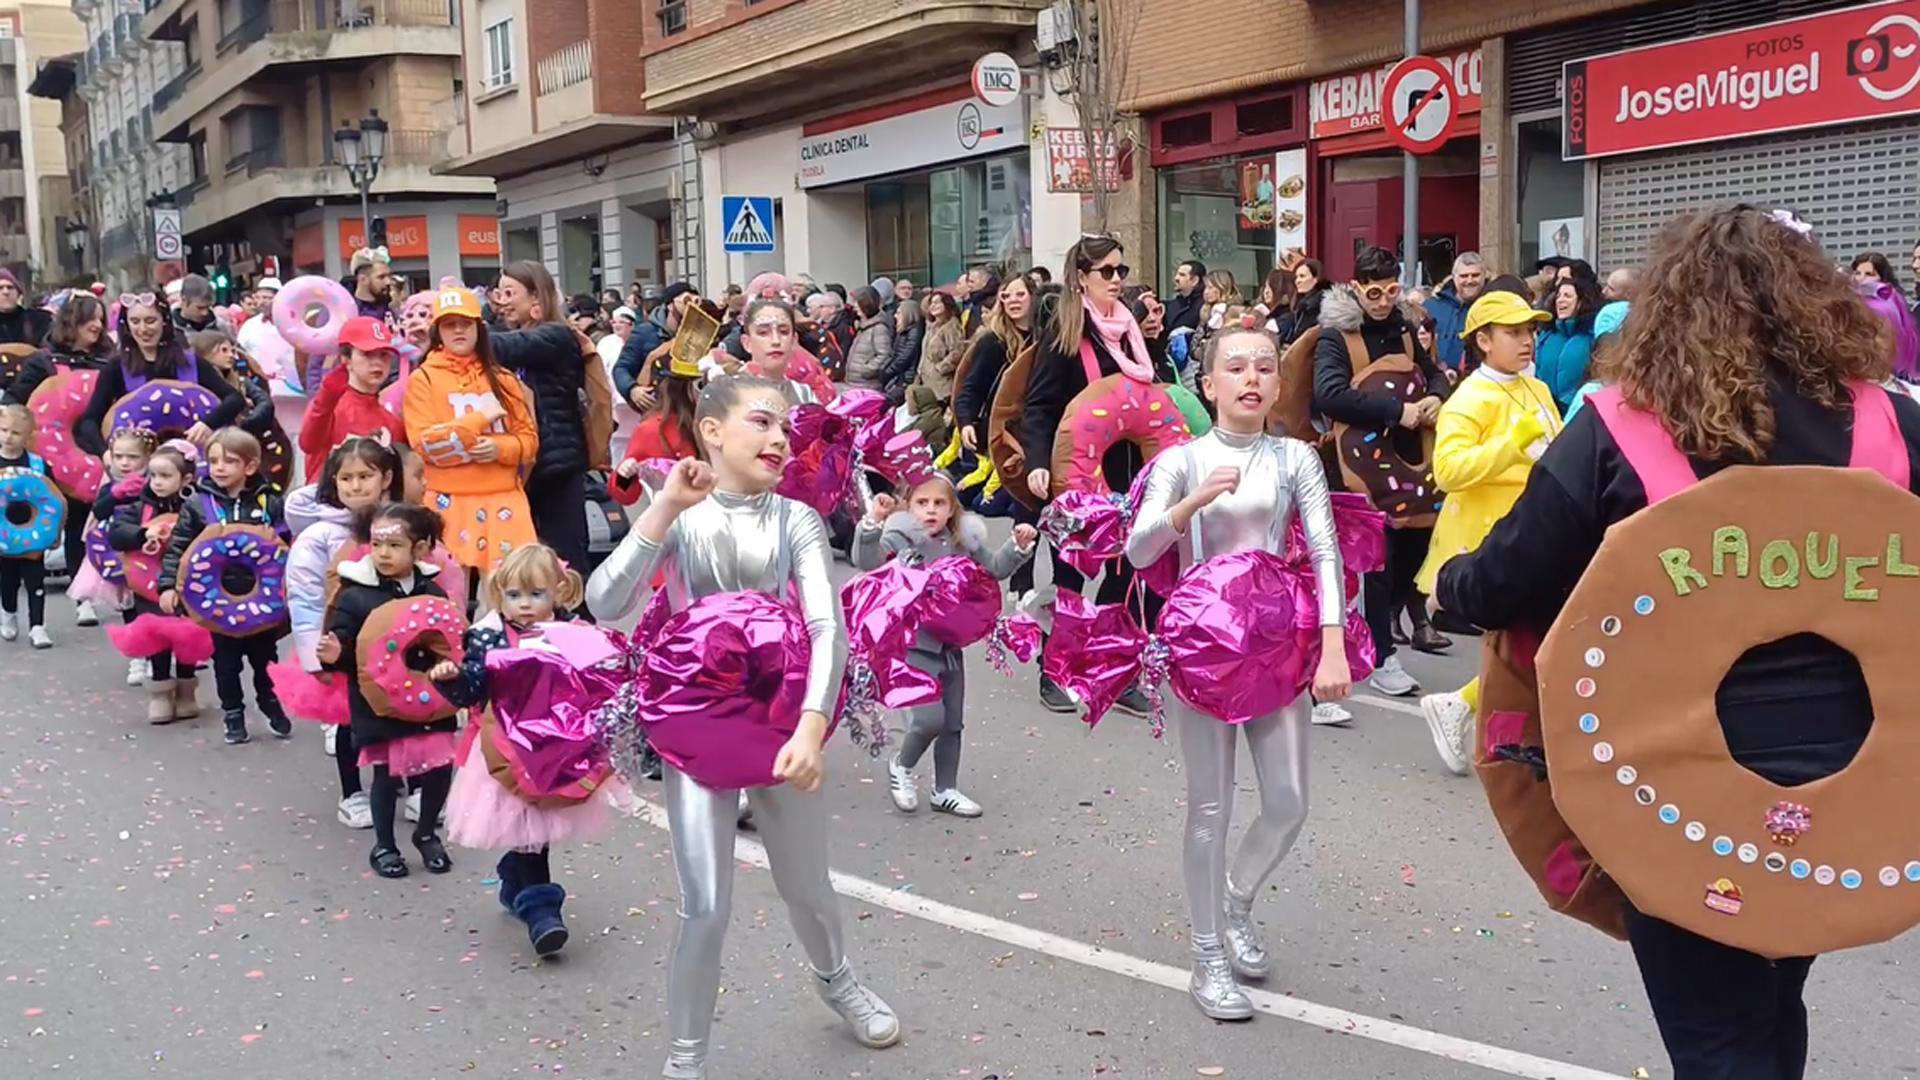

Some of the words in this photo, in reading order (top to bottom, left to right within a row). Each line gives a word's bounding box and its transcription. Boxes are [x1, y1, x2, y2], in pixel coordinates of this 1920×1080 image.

[1746, 34, 1804, 59] FOTOS
[984, 71, 1016, 92] IMQ
[1570, 75, 1584, 144] FOTOS
[1350, 114, 1381, 128] BAR
[835, 133, 869, 154] DENTAL
[440, 290, 464, 309] m
[1658, 525, 1920, 601] RAQUEL
